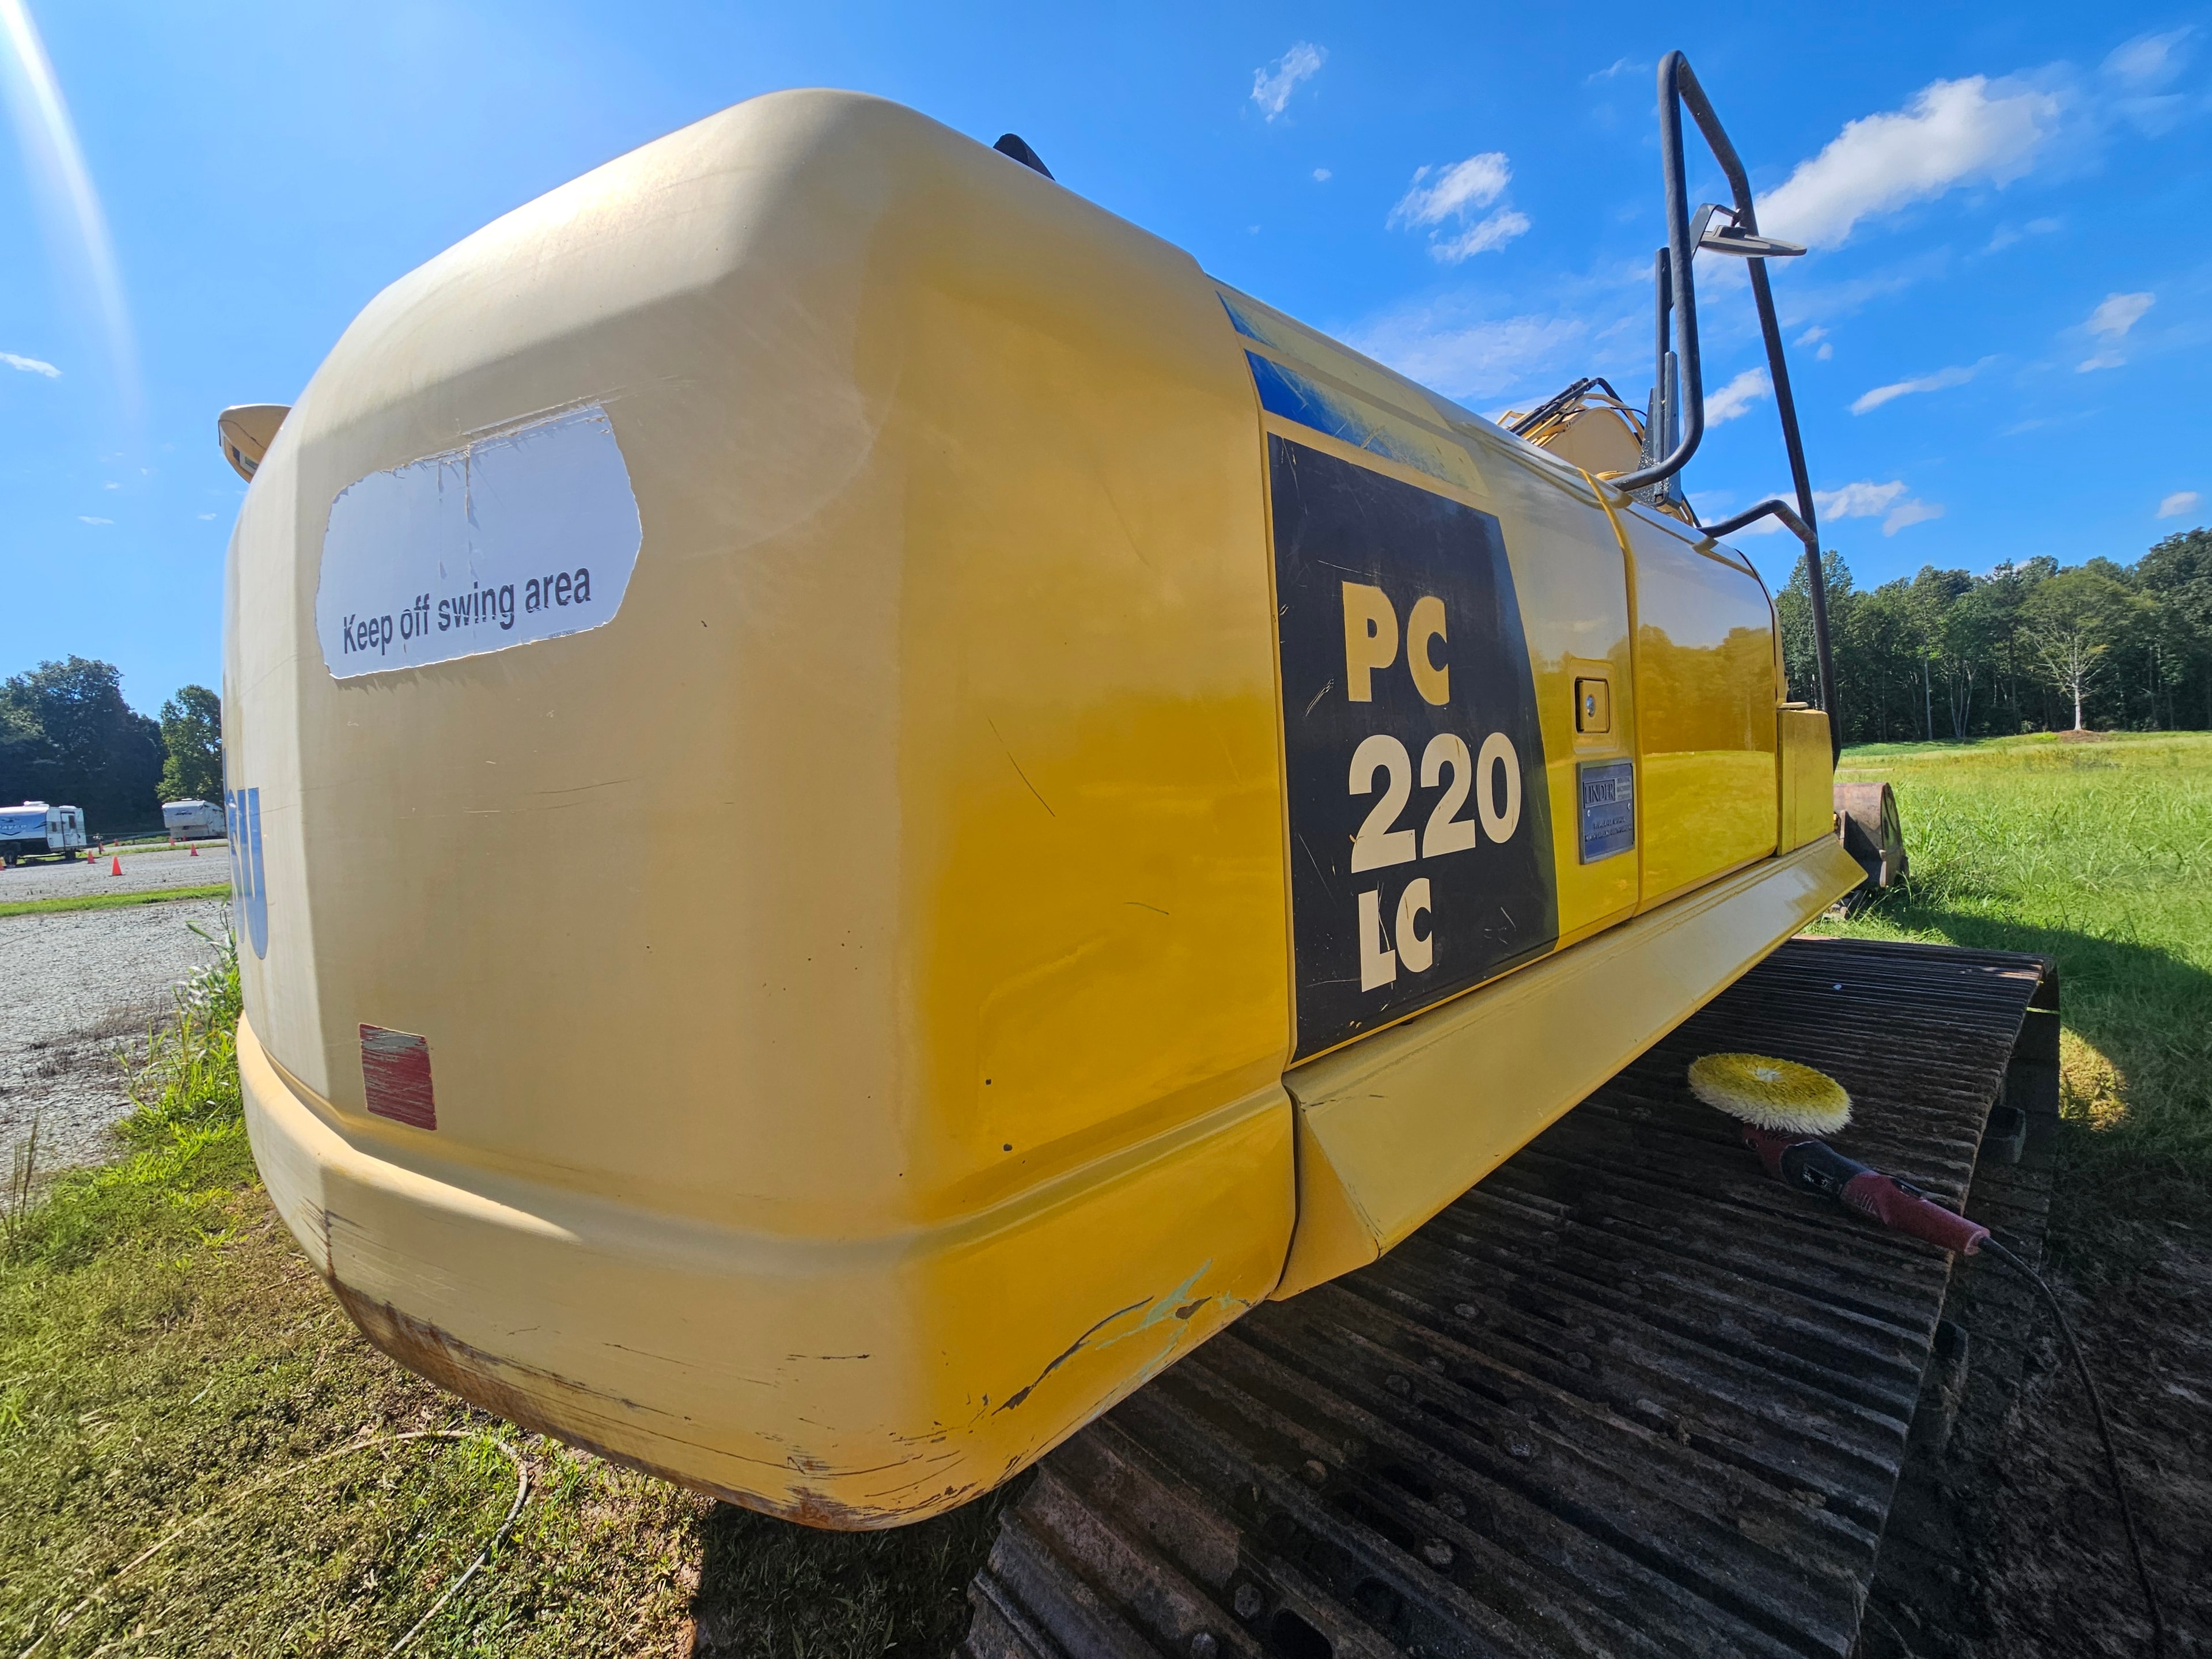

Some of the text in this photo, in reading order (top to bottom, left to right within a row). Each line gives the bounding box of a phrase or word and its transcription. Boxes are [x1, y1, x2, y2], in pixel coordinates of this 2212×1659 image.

[344, 567, 591, 656] Keep off swing area
[1343, 581, 1450, 705] PC
[1349, 732, 1521, 873] 220
[1585, 783, 1614, 804] LINDER
[1358, 877, 1433, 993] LC
